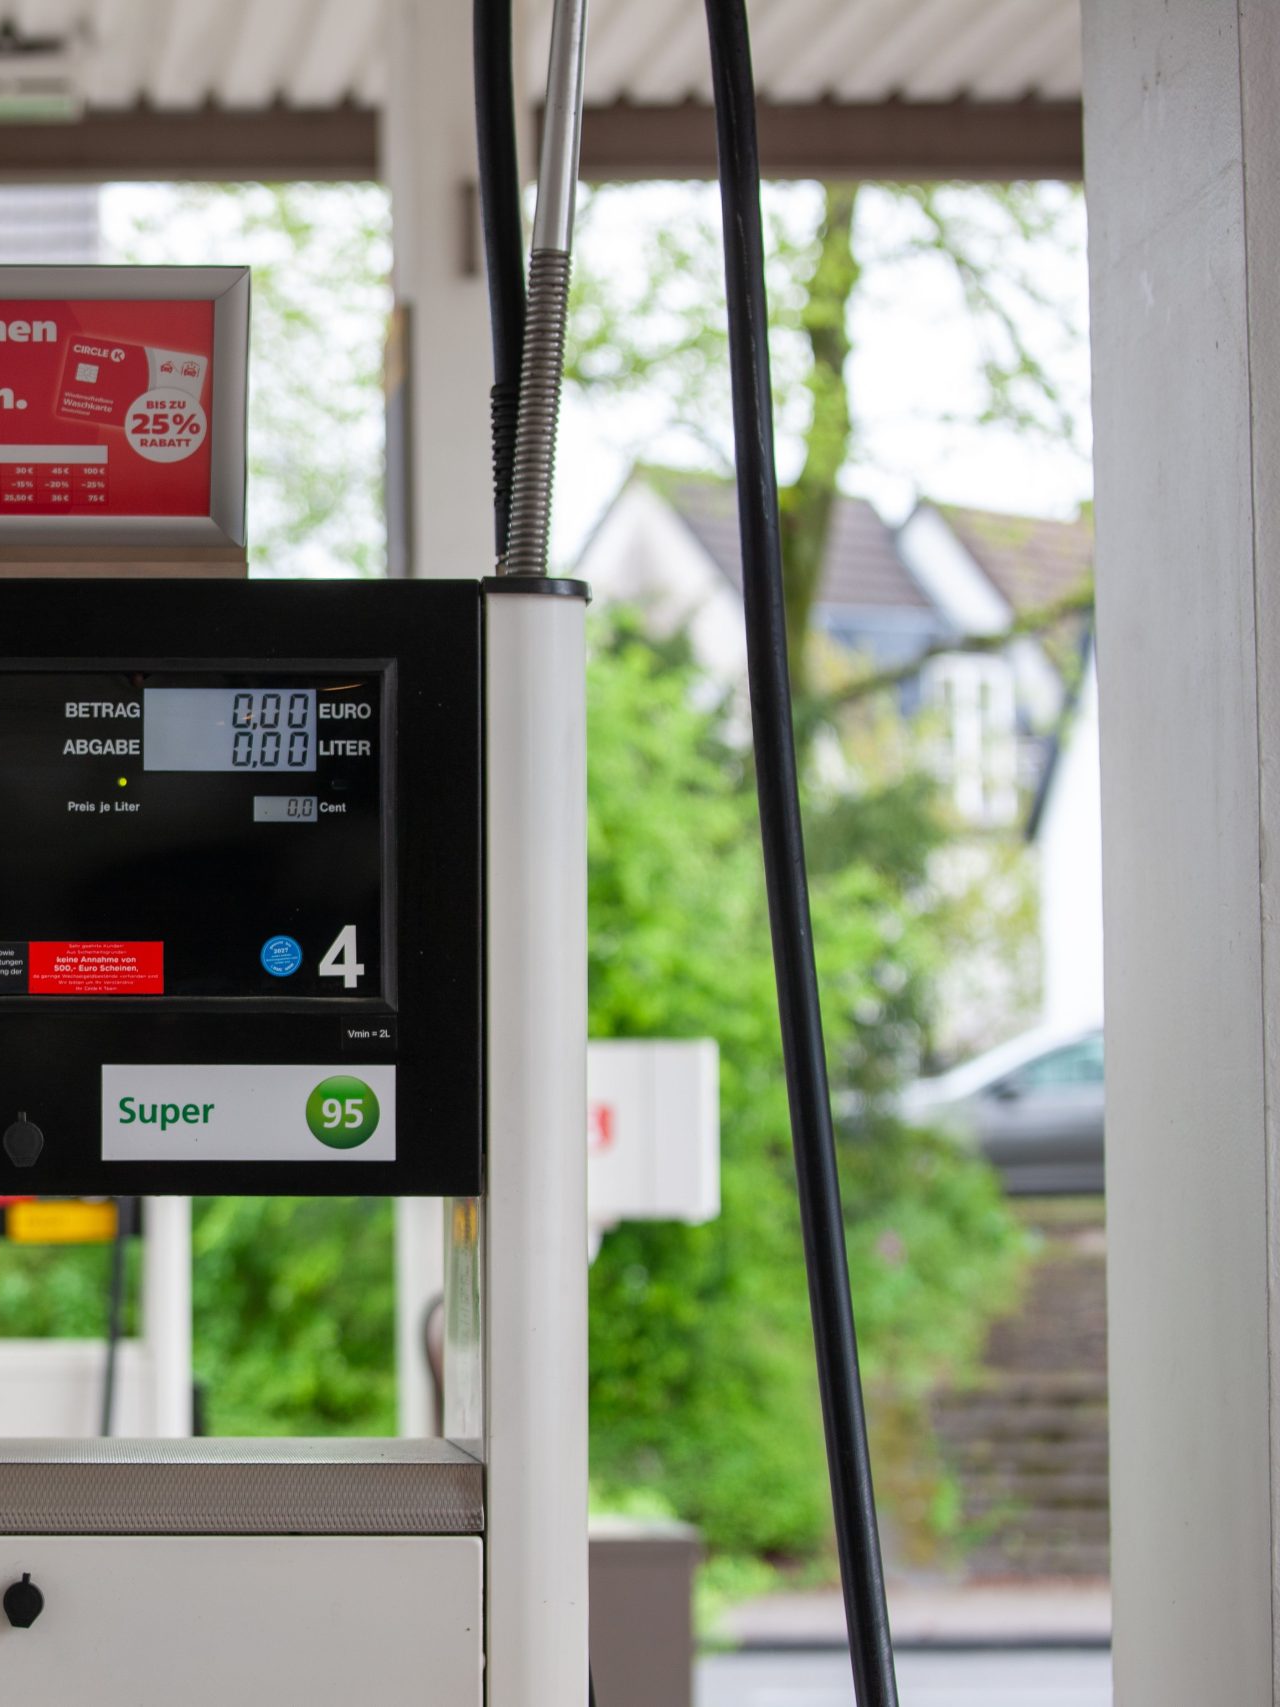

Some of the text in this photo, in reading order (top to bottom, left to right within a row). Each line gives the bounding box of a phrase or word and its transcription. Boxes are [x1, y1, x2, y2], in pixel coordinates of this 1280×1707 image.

[73, 344, 109, 358] CIRCLE
[63, 398, 112, 413] Waschkarte
[146, 400, 186, 409] BIS ZU
[131, 413, 201, 435] 25%
[140, 438, 192, 448] RABATT
[65, 703, 140, 718] BETRAG
[232, 694, 309, 730] 0,00
[319, 704, 371, 719] EURO
[63, 740, 140, 755] ABGABE
[232, 732, 309, 768] 0,00
[319, 740, 370, 756] LITER
[68, 801, 140, 813] Preis je Liter
[287, 798, 313, 818] 0,0
[320, 802, 346, 813] Cent
[318, 924, 365, 988] 4
[348, 1030, 370, 1038] Vmin
[380, 1030, 390, 1038] 2L
[119, 1097, 215, 1131] Super
[322, 1099, 364, 1129] 95
